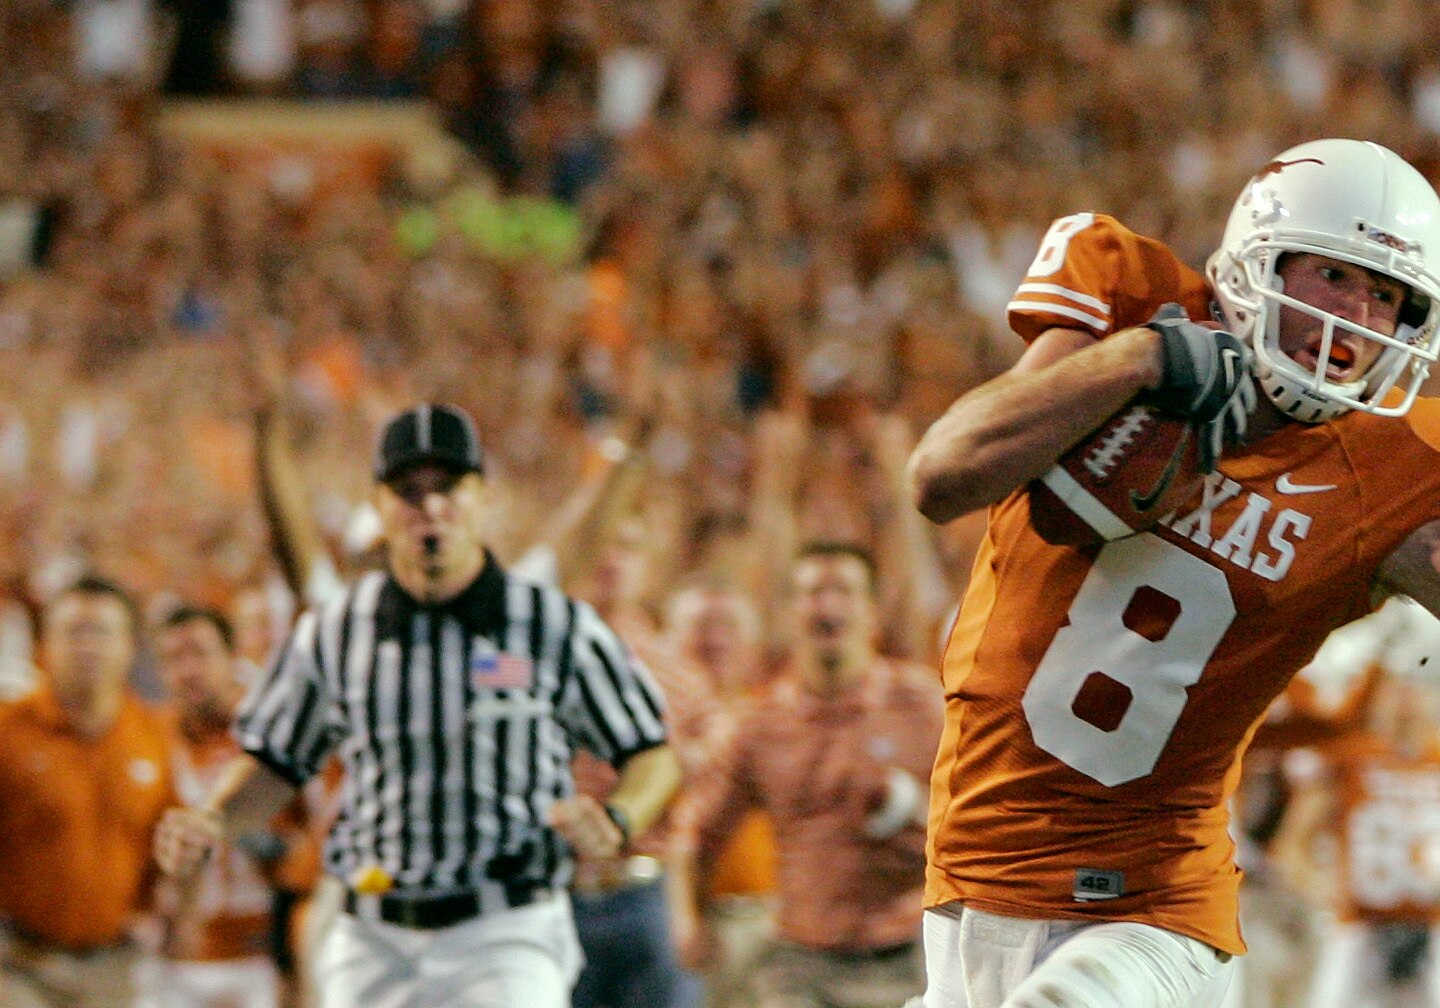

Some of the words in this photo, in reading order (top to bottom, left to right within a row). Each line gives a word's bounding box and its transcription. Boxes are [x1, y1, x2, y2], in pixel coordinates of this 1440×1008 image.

[1027, 211, 1094, 276] 8
[1157, 470, 1313, 582] XAS
[1022, 530, 1238, 788] 8
